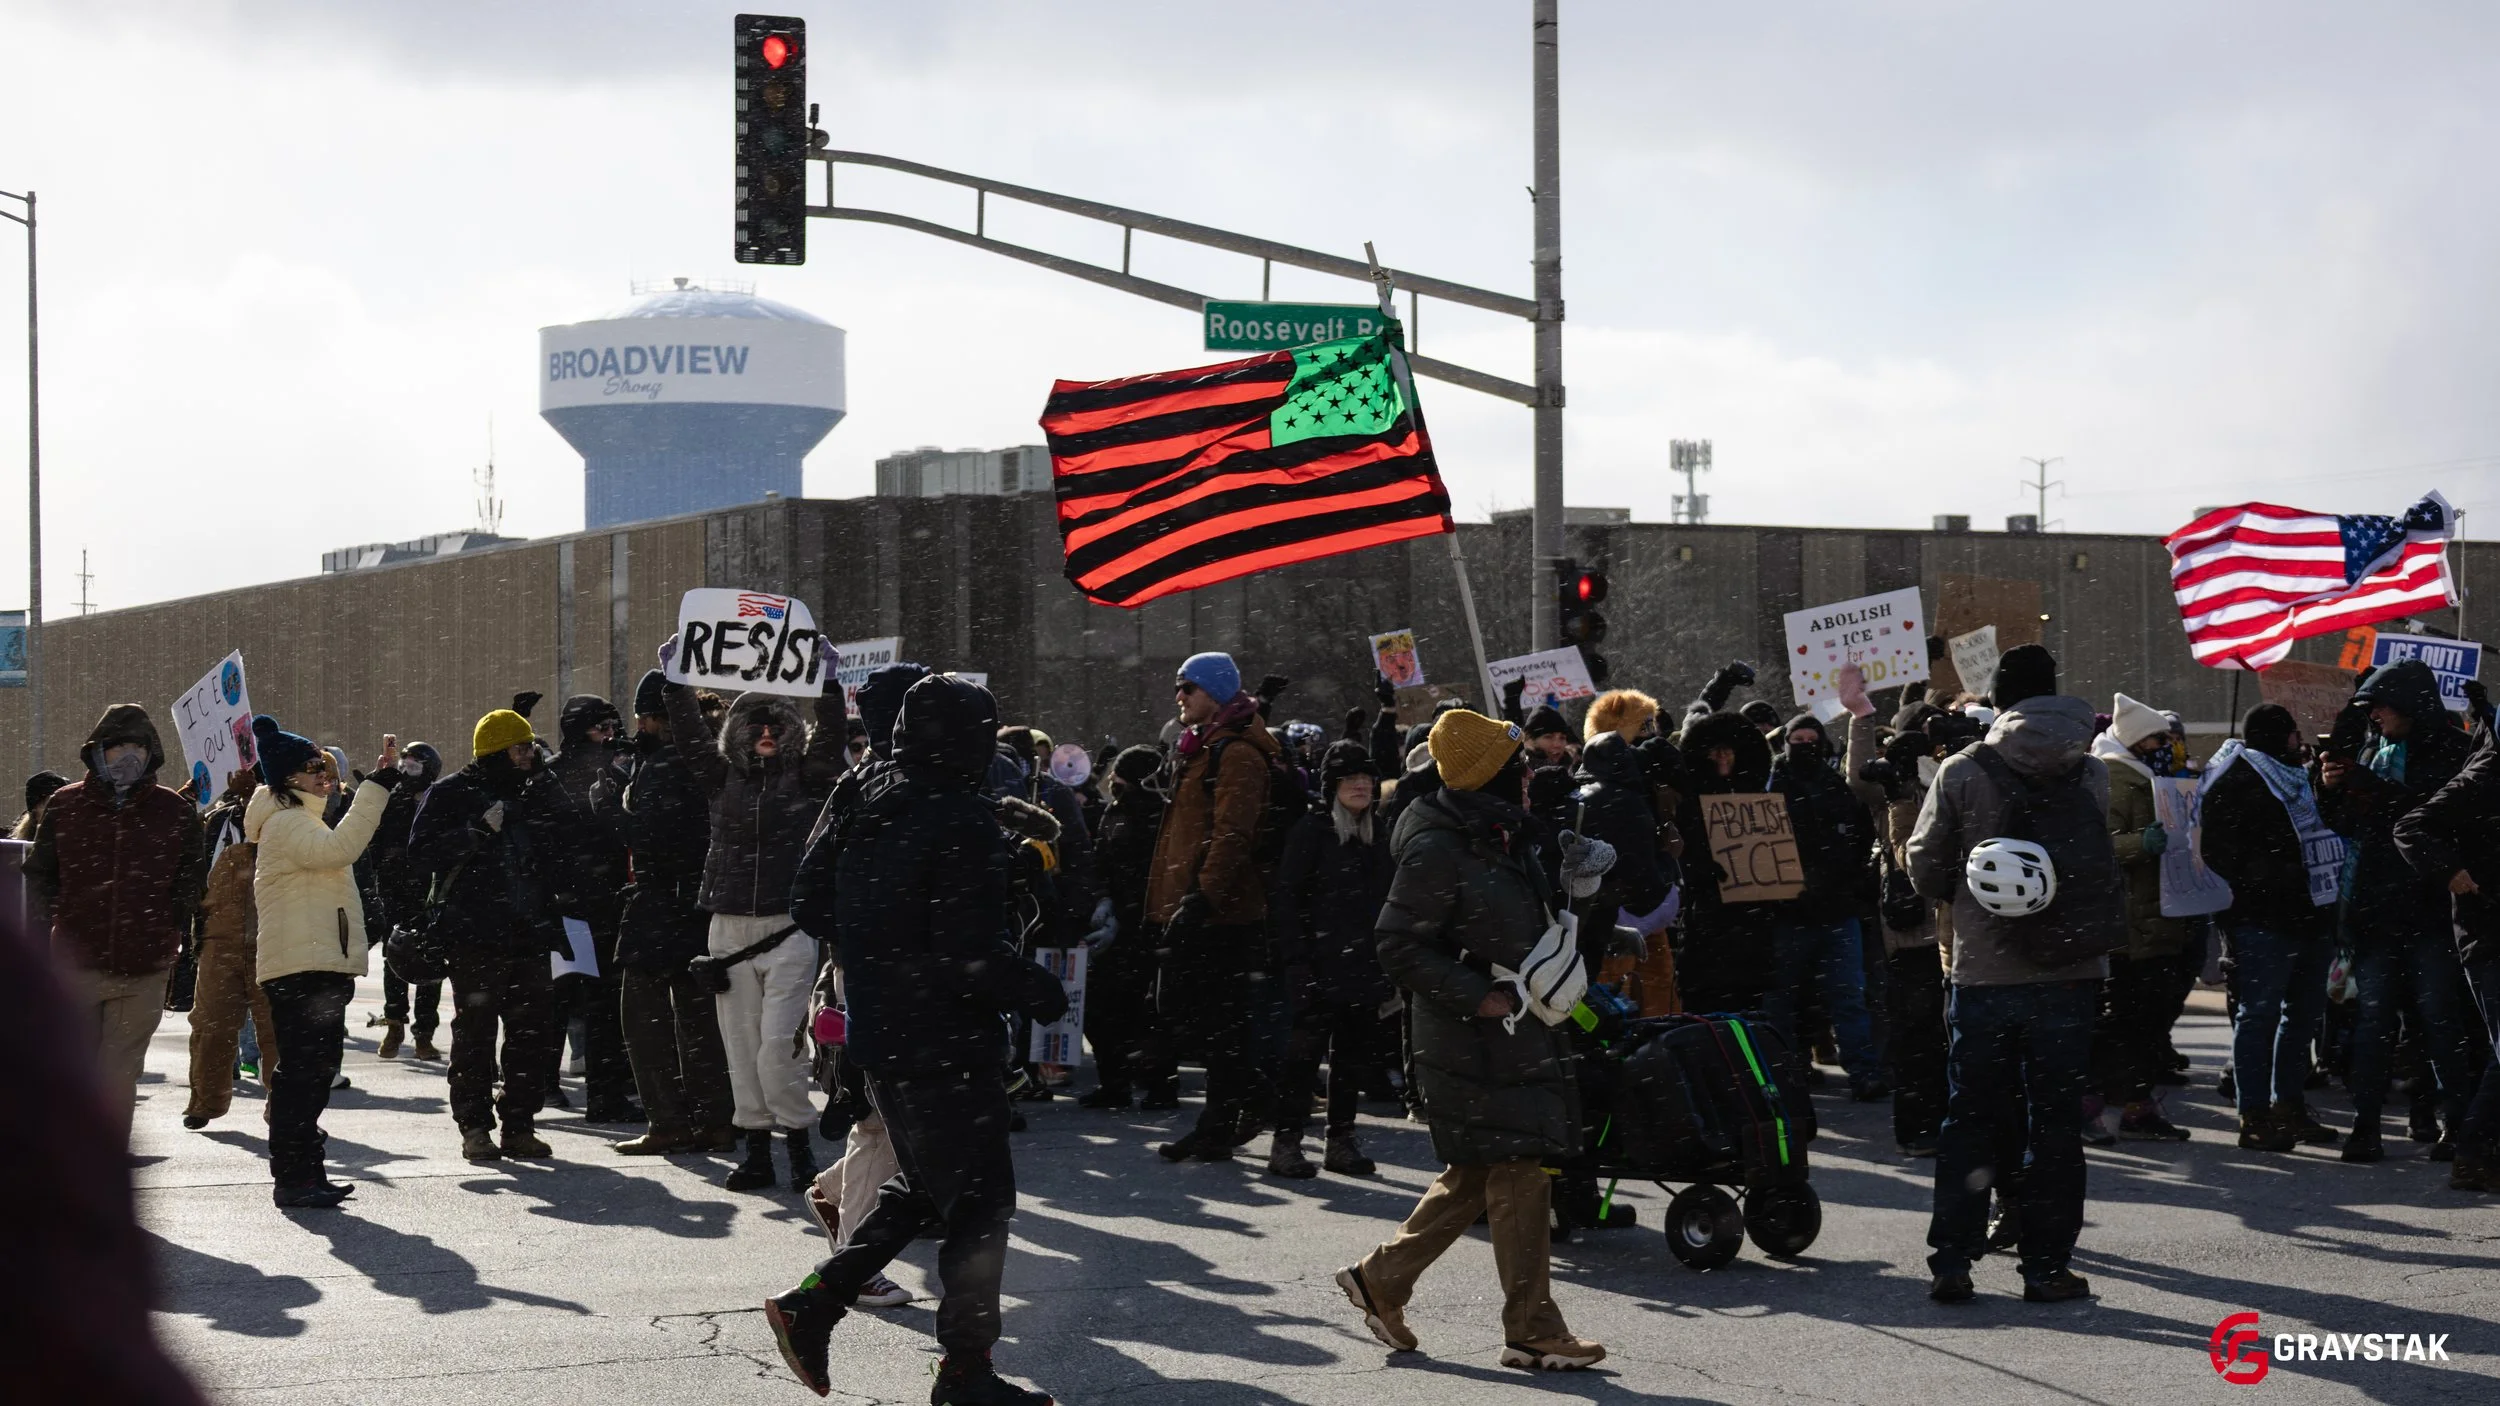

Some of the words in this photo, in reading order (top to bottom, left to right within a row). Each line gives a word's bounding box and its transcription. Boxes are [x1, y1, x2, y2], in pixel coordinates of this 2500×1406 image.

[1209, 313, 1345, 342] Roosevelt
[549, 345, 749, 382] BROADVIEW
[602, 375, 663, 399] Strong
[1810, 603, 1892, 632] ABOLISH
[679, 599, 821, 684] RESIST
[1842, 629, 1873, 646] ICE
[838, 654, 856, 669] NOT
[858, 653, 866, 666] A
[868, 650, 891, 664] PAID
[1847, 645, 1865, 663] for
[2388, 642, 2418, 660] ICE
[2420, 645, 2464, 672] OUT!
[1523, 677, 1572, 696] OUR
[1829, 655, 1898, 689] GOD!
[182, 675, 221, 730] ICE
[204, 717, 235, 763] OUT
[1708, 798, 1793, 839] ABOLISH
[1715, 839, 1804, 892] ICE
